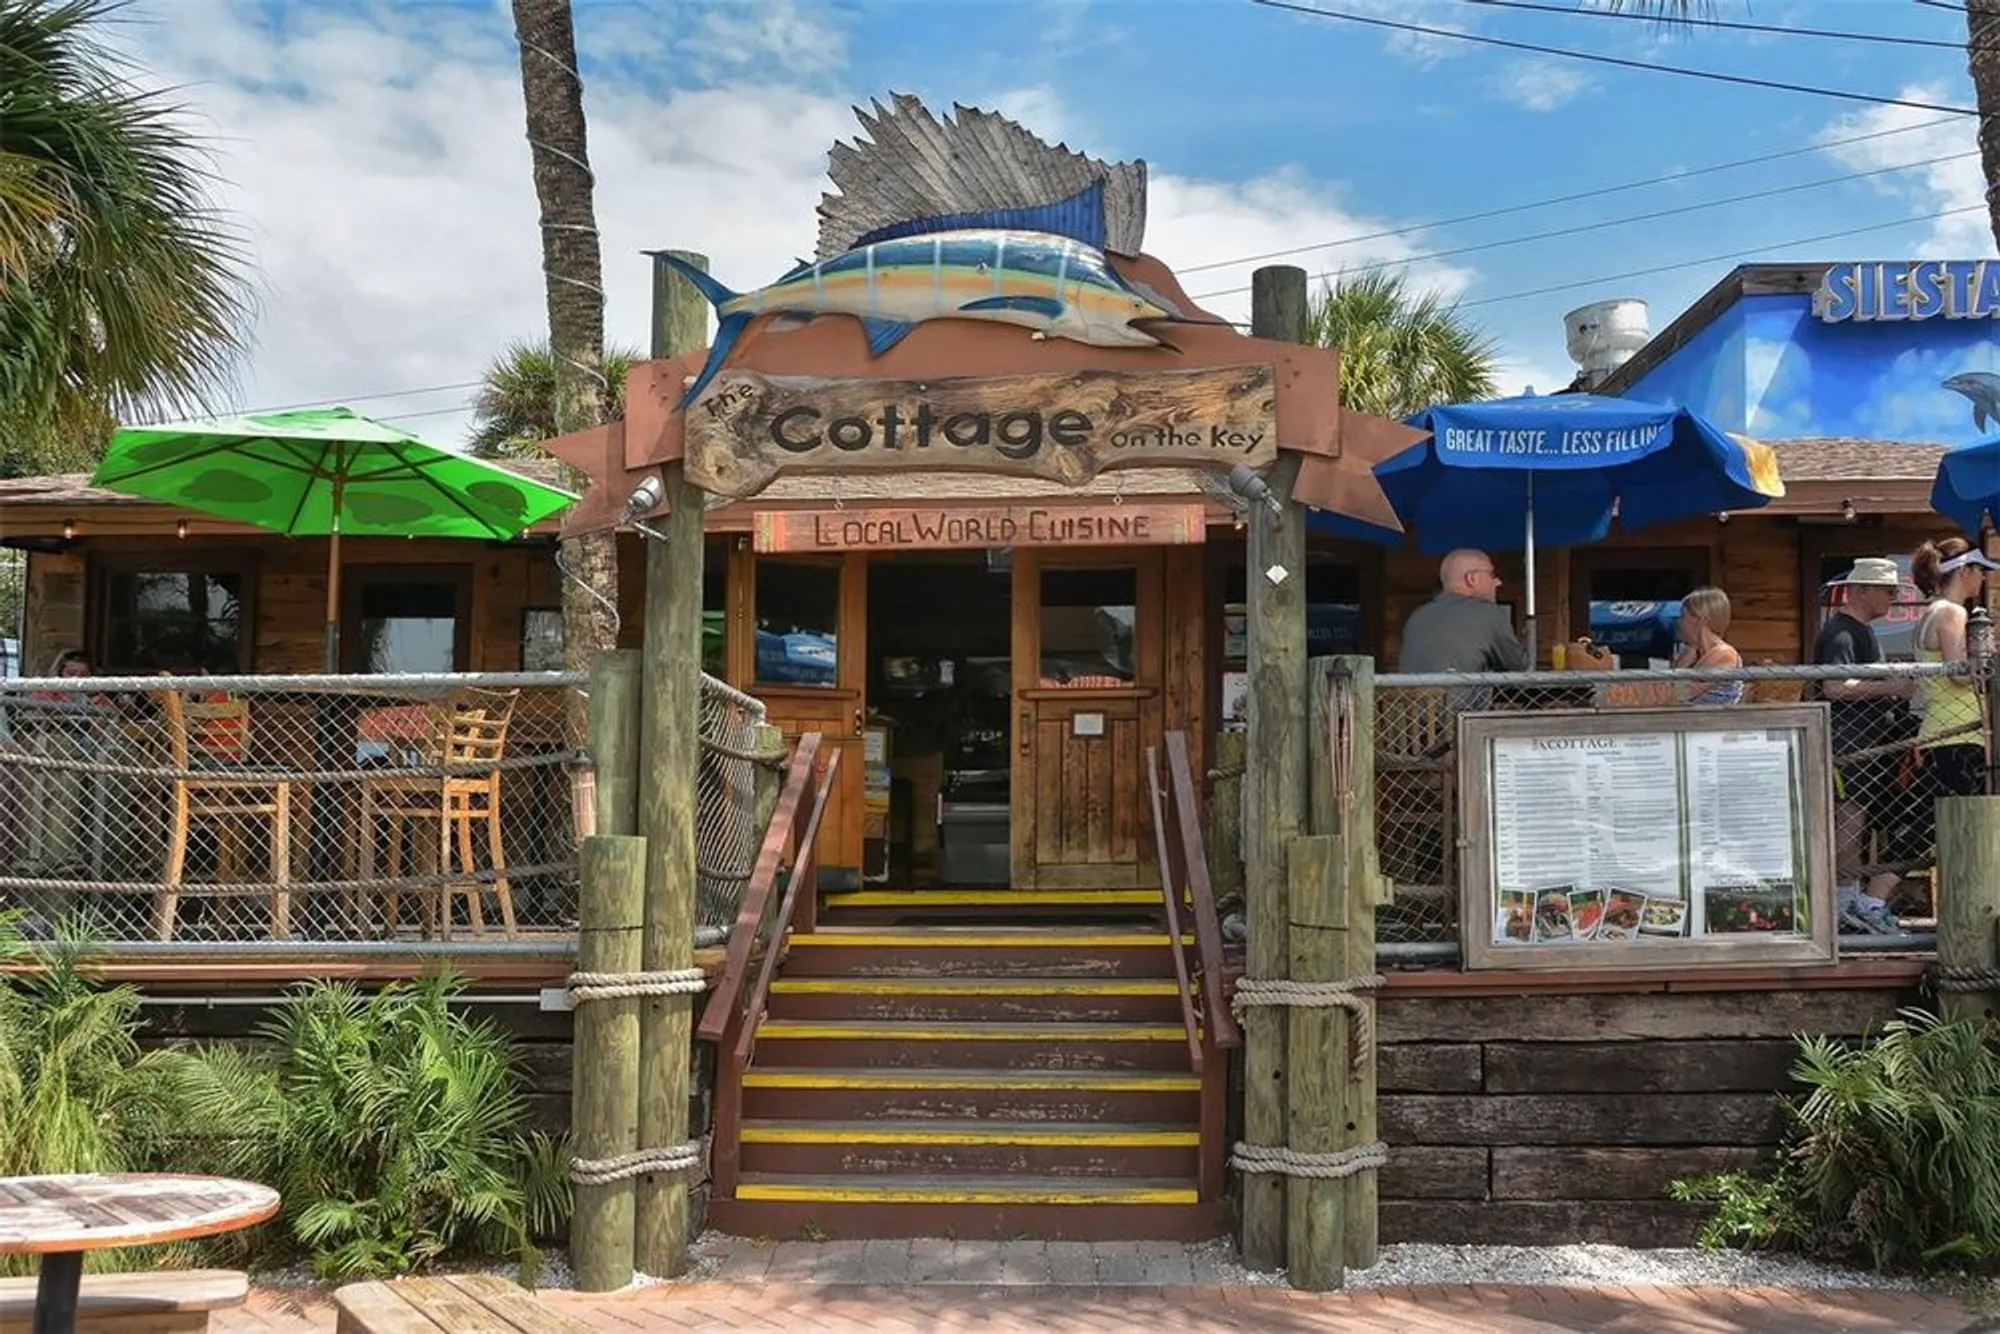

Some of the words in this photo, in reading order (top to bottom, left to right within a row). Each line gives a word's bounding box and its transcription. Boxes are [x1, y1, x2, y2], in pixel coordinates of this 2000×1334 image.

[703, 381, 754, 417] The
[770, 404, 1093, 459] Cottage
[1154, 425, 1201, 448] the
[1446, 427, 1495, 452] GREAT
[1498, 430, 1558, 454] TASTE...
[1562, 430, 1602, 454] LESS
[914, 512, 1017, 542] WORLD
[1029, 511, 1151, 541] CUISINE
[1546, 737, 1617, 750] COTTAGE
